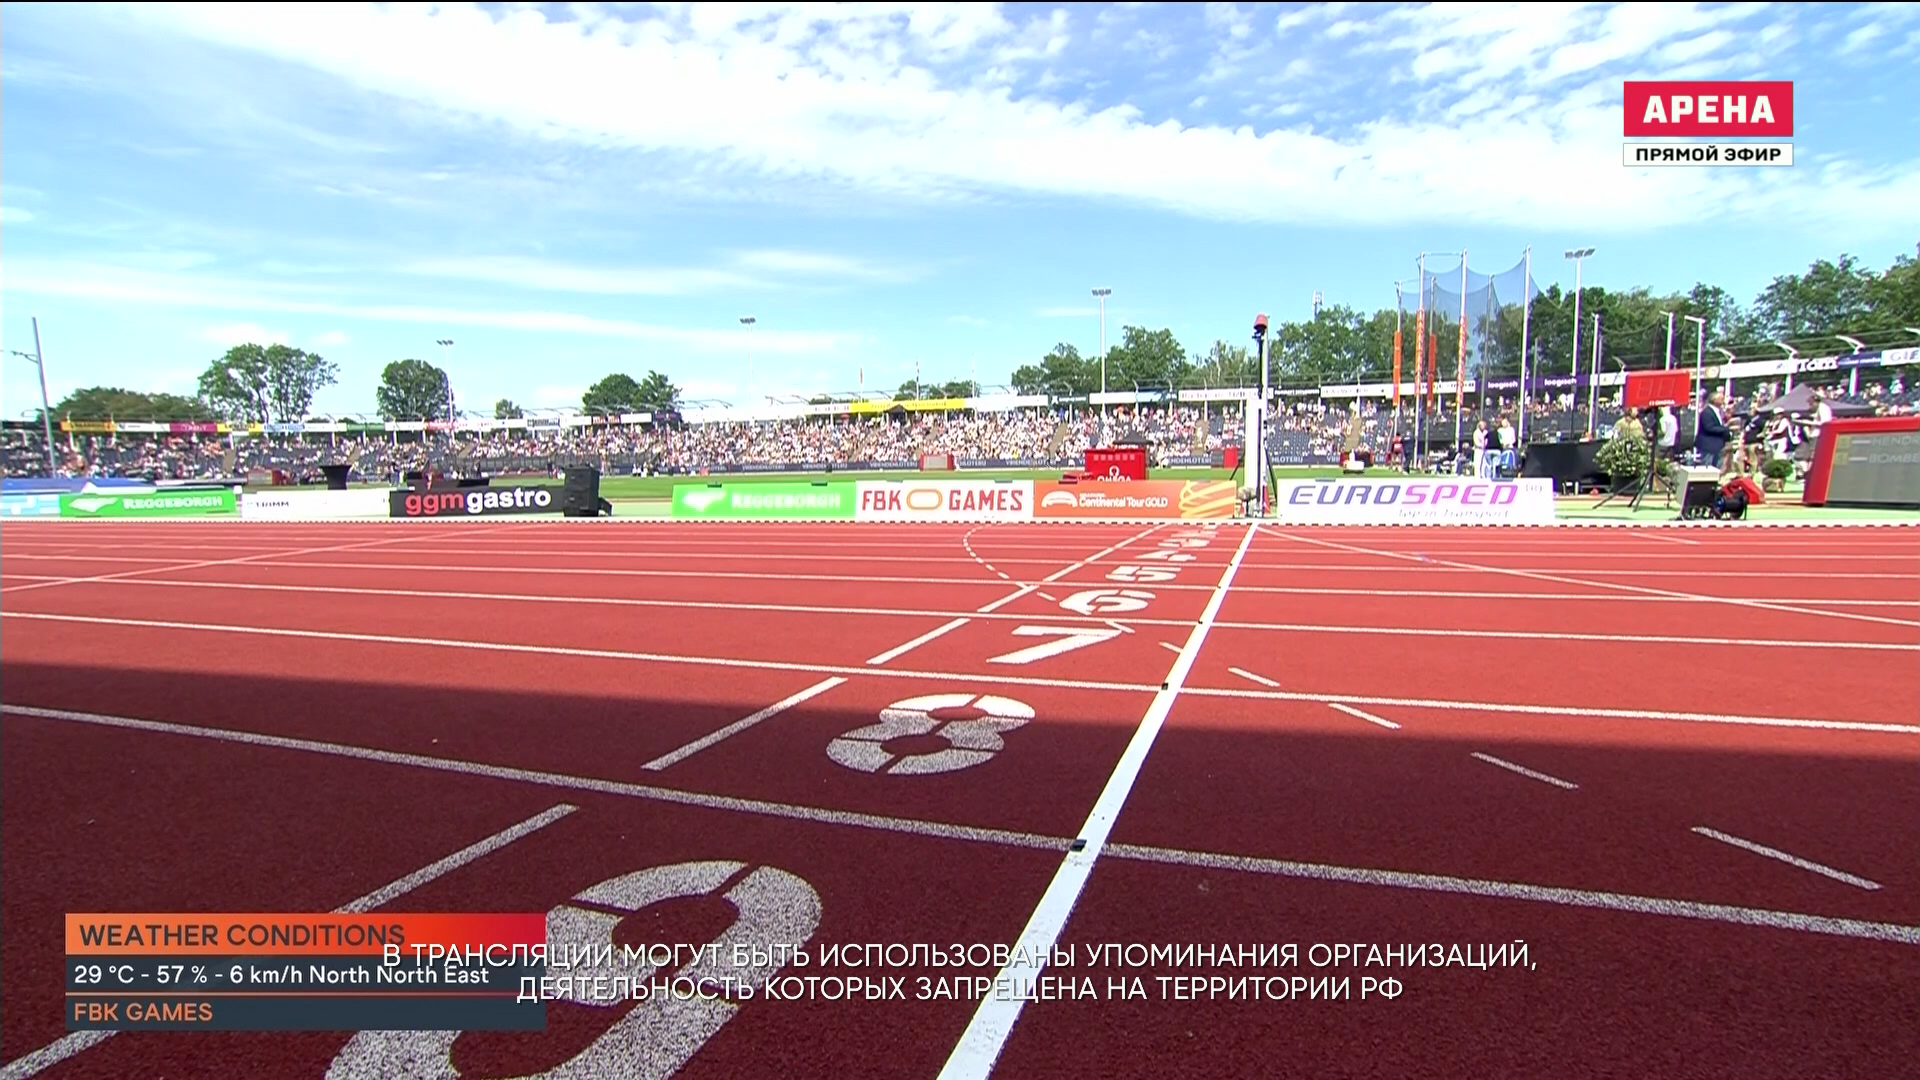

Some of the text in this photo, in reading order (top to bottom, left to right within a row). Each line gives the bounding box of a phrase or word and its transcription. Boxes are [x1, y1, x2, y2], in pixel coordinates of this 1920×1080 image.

[862, 490, 1023, 511] FBK GAMES
[1079, 496, 1168, 508] Continental Tour GOLD
[1288, 485, 1519, 505] EUROSPED
[1105, 566, 1182, 581] 5
[1059, 589, 1156, 615] 6
[988, 625, 1122, 665] 7
[826, 694, 1036, 776] 8
[324, 860, 822, 1080] 9
